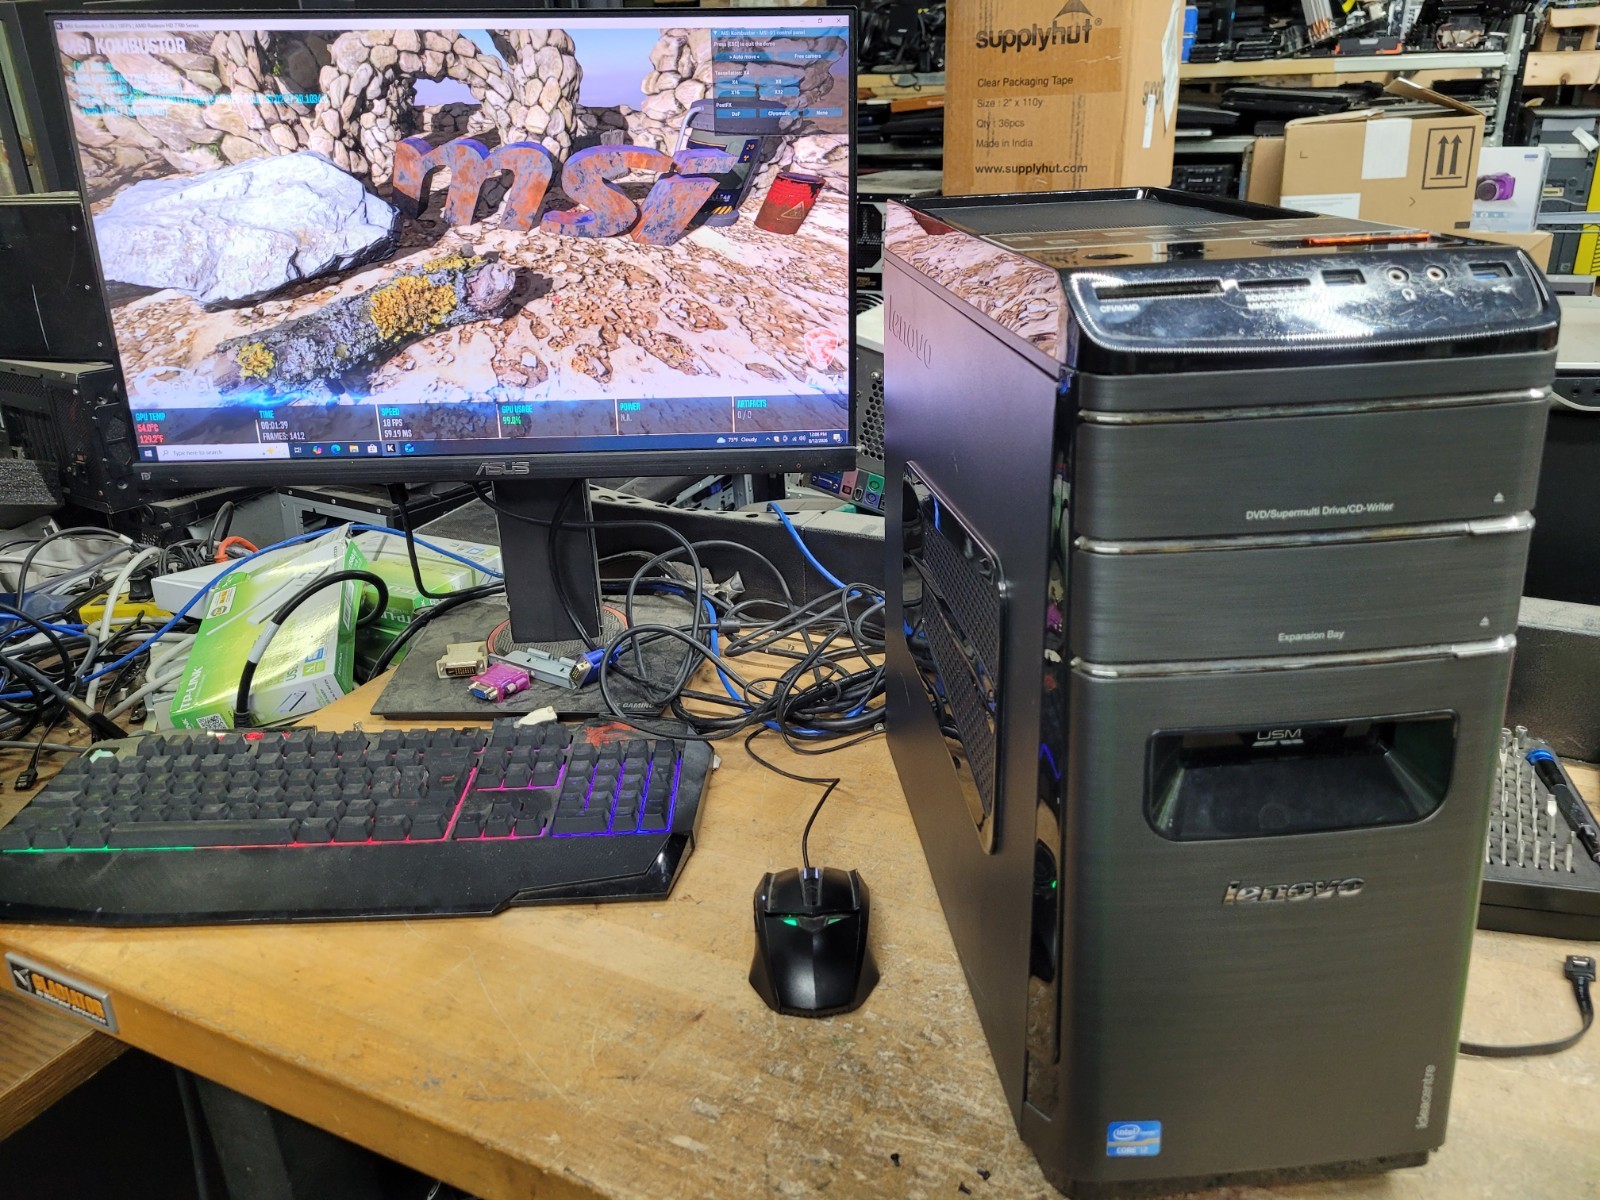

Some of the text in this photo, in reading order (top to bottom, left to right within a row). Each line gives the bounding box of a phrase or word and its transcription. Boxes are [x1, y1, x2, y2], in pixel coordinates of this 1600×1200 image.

[976, 18, 1093, 53] supplyhut
[95, 37, 187, 54] KOMBUSTOR
[977, 76, 1074, 88] Clear Packaging Tape
[977, 99, 996, 108] Size
[1023, 98, 1043, 109] 110y
[976, 119, 991, 130] Qty
[998, 118, 1025, 130] 36pcs
[976, 138, 1033, 148] Made in India
[975, 163, 1088, 175] www.supplyhut.com
[620, 403, 641, 411] POWER
[737, 399, 767, 408] ARTIFACTS
[259, 410, 275, 419] TIME
[381, 408, 400, 416] SPEED
[501, 405, 533, 414] GPU USAGE
[135, 412, 166, 421] GPU TEMP
[261, 421, 289, 430] 00:01:39
[383, 418, 403, 427] 18 FPS
[263, 432, 306, 441] FRAMES: 1412
[384, 429, 412, 438] 59.19 MS
[476, 461, 530, 475] ASUS
[1246, 502, 1394, 520] DVD/Supermulti Drive/CD-Writer
[1278, 629, 1345, 643] Expansion Bay
[1256, 728, 1302, 740] USM
[1223, 877, 1365, 905] lenovo
[1415, 1064, 1436, 1129] ideacentre
[1115, 1127, 1136, 1136] intel
